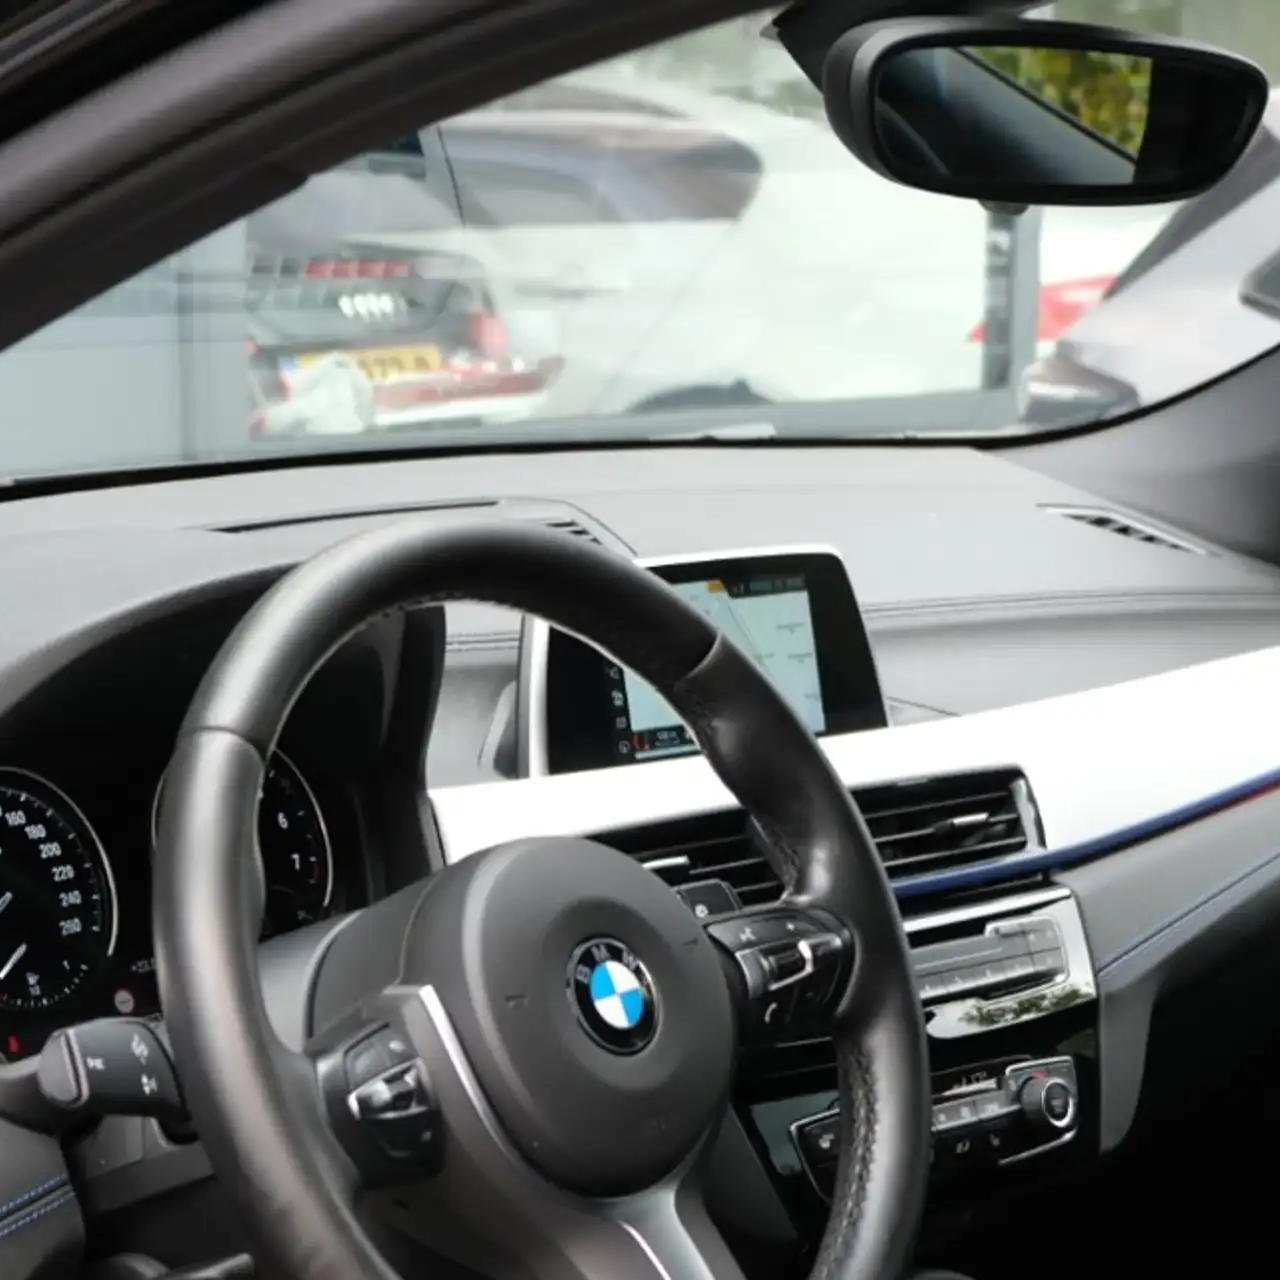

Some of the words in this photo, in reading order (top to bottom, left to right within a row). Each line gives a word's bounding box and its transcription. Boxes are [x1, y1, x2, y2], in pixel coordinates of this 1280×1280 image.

[5, 810, 26, 826] 160
[277, 811, 288, 830] 6
[24, 823, 47, 840] 180
[38, 841, 62, 859] 200
[51, 864, 74, 881] 220
[59, 890, 81, 907] 240
[59, 917, 82, 936] 260
[576, 943, 639, 984] BMW
